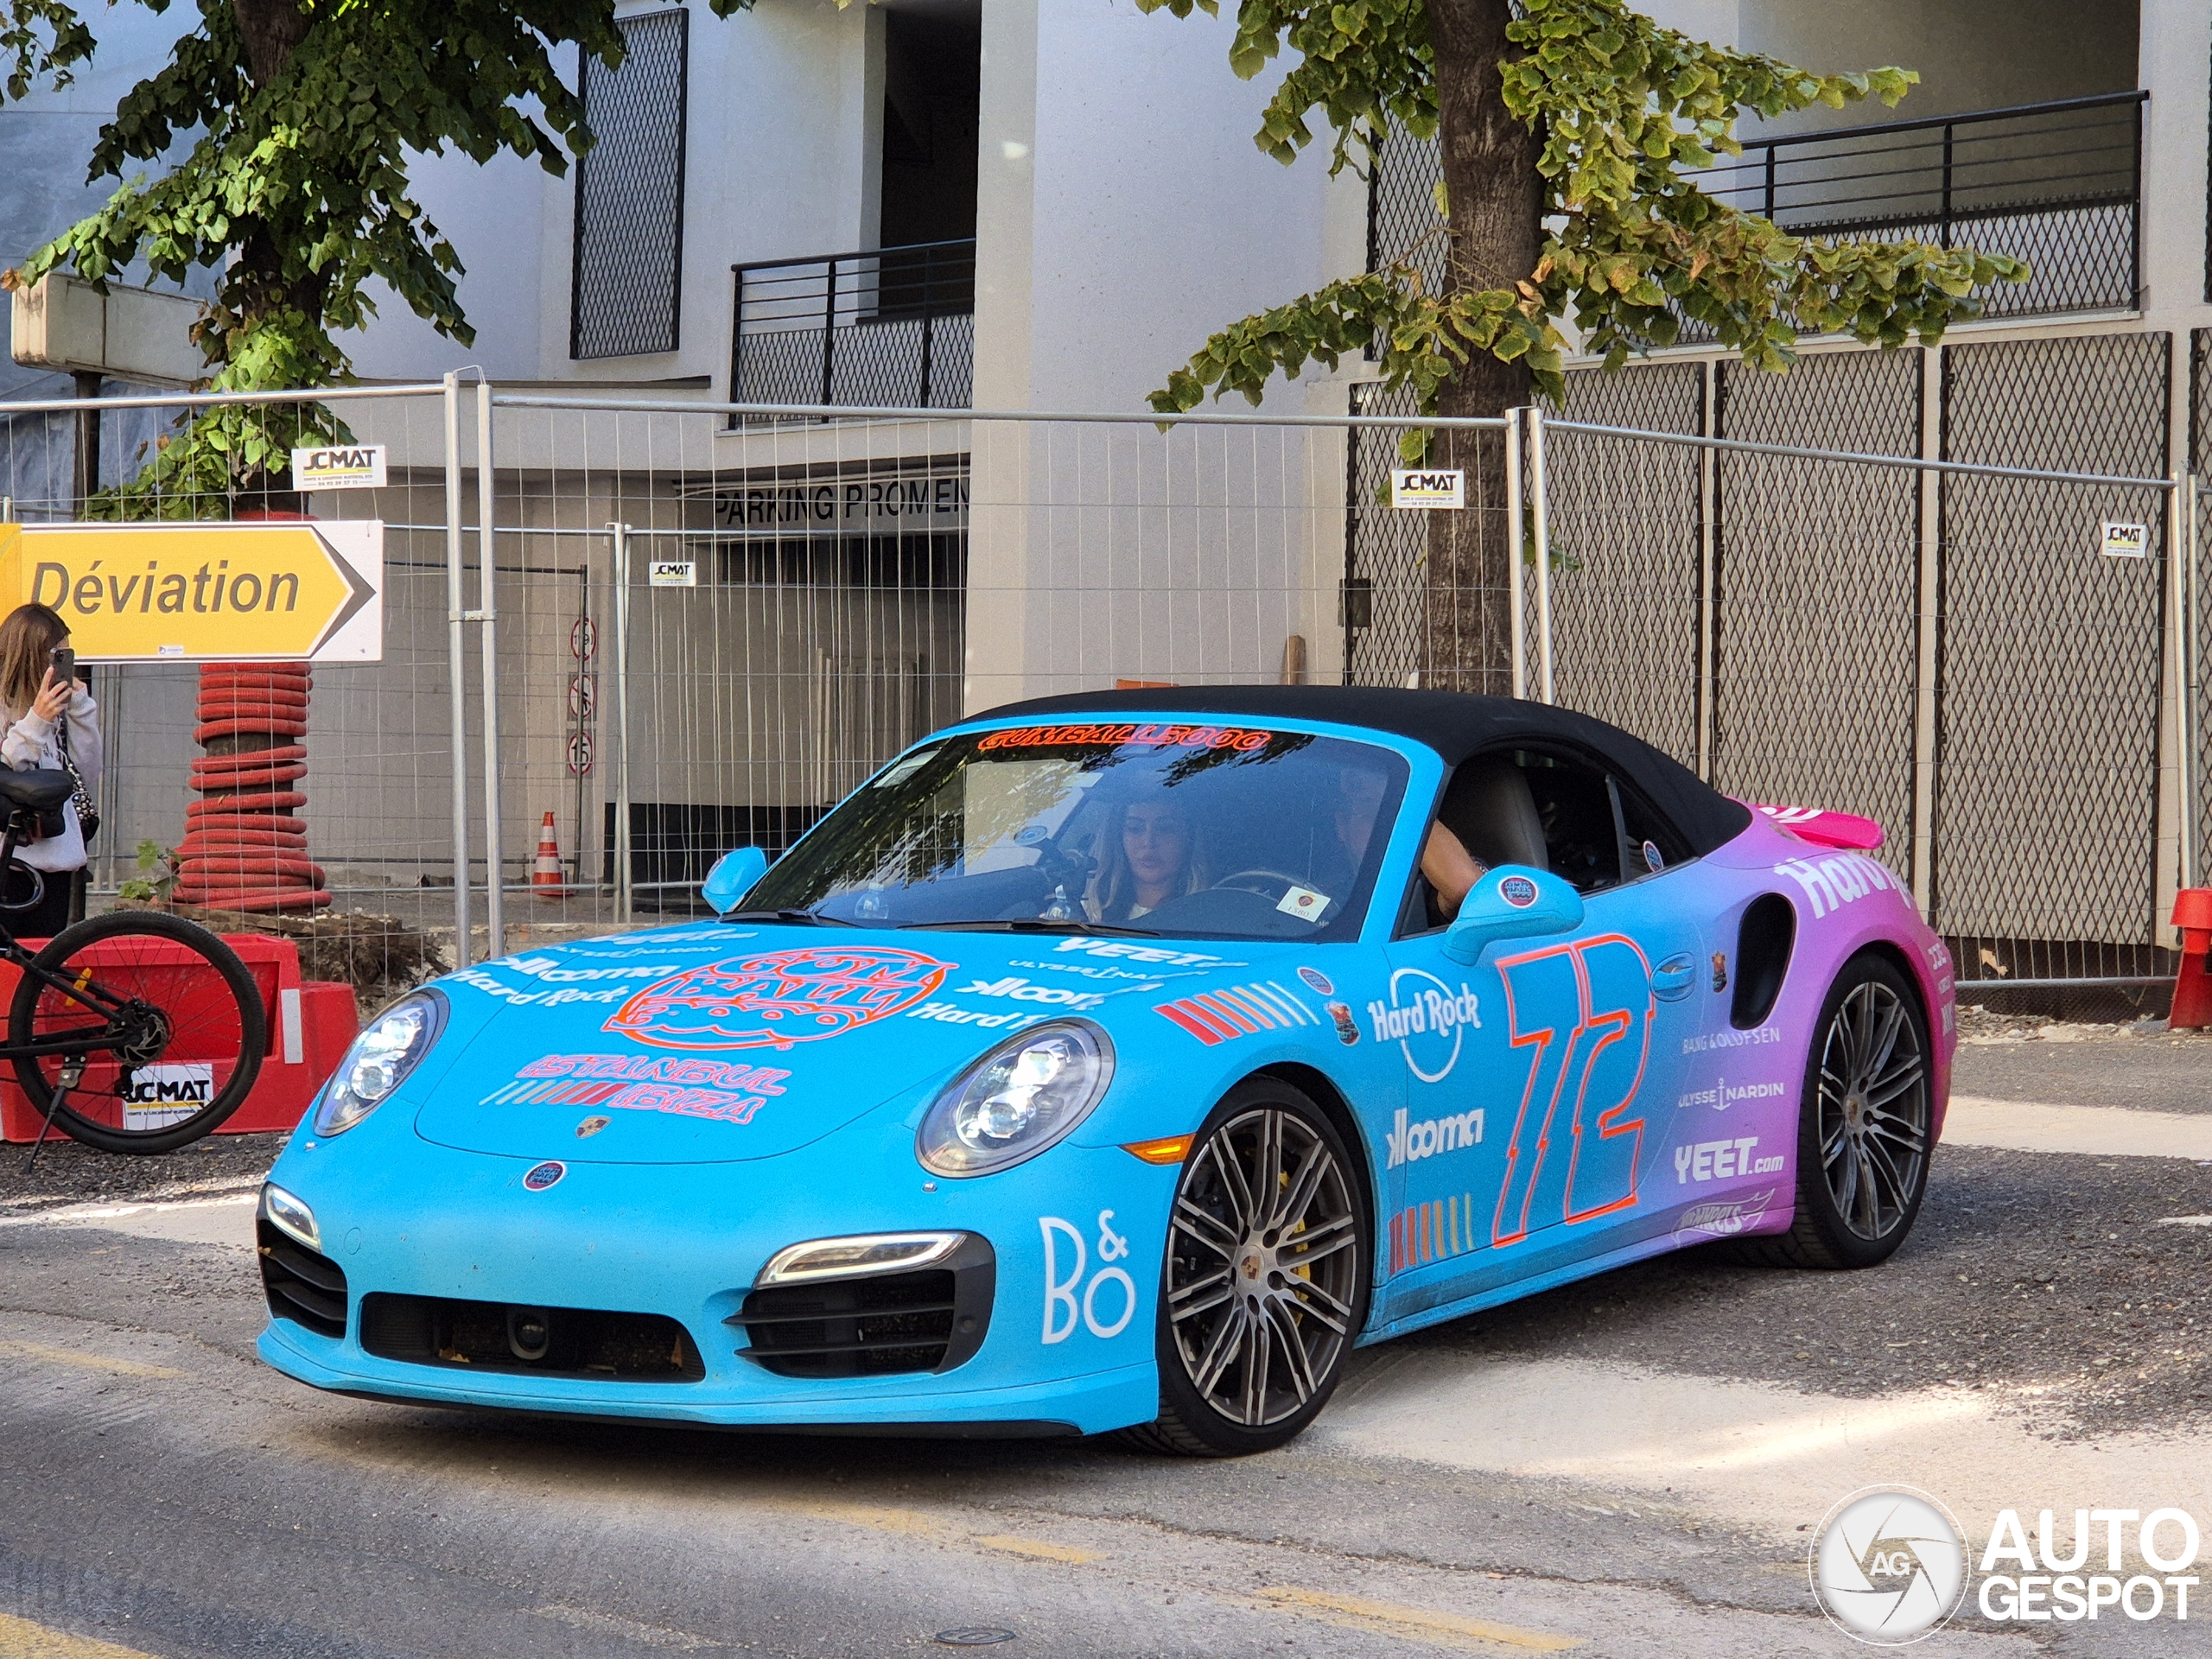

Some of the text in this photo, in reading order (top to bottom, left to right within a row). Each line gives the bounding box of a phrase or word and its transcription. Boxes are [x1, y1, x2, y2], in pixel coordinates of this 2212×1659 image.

[303, 449, 377, 471] JCMAT
[1400, 474, 1457, 491] JCMAT
[715, 486, 834, 524] PARKING
[2107, 527, 2141, 543] JCMAT
[654, 564, 690, 575] JCMAT
[31, 560, 300, 615] Déviation
[1368, 982, 1483, 1043] Hard Rock
[1682, 1034, 1707, 1055] BANG
[1716, 1027, 1782, 1048] OLUFSEN
[127, 1079, 209, 1103] JCMAT
[514, 1053, 793, 1096] ISTANBUL
[1492, 933, 1656, 1249] 72
[607, 1083, 767, 1125] IBIZA
[1678, 1082, 1785, 1109] ULYSSE NARDIN
[1674, 1136, 1785, 1185] YEET.com
